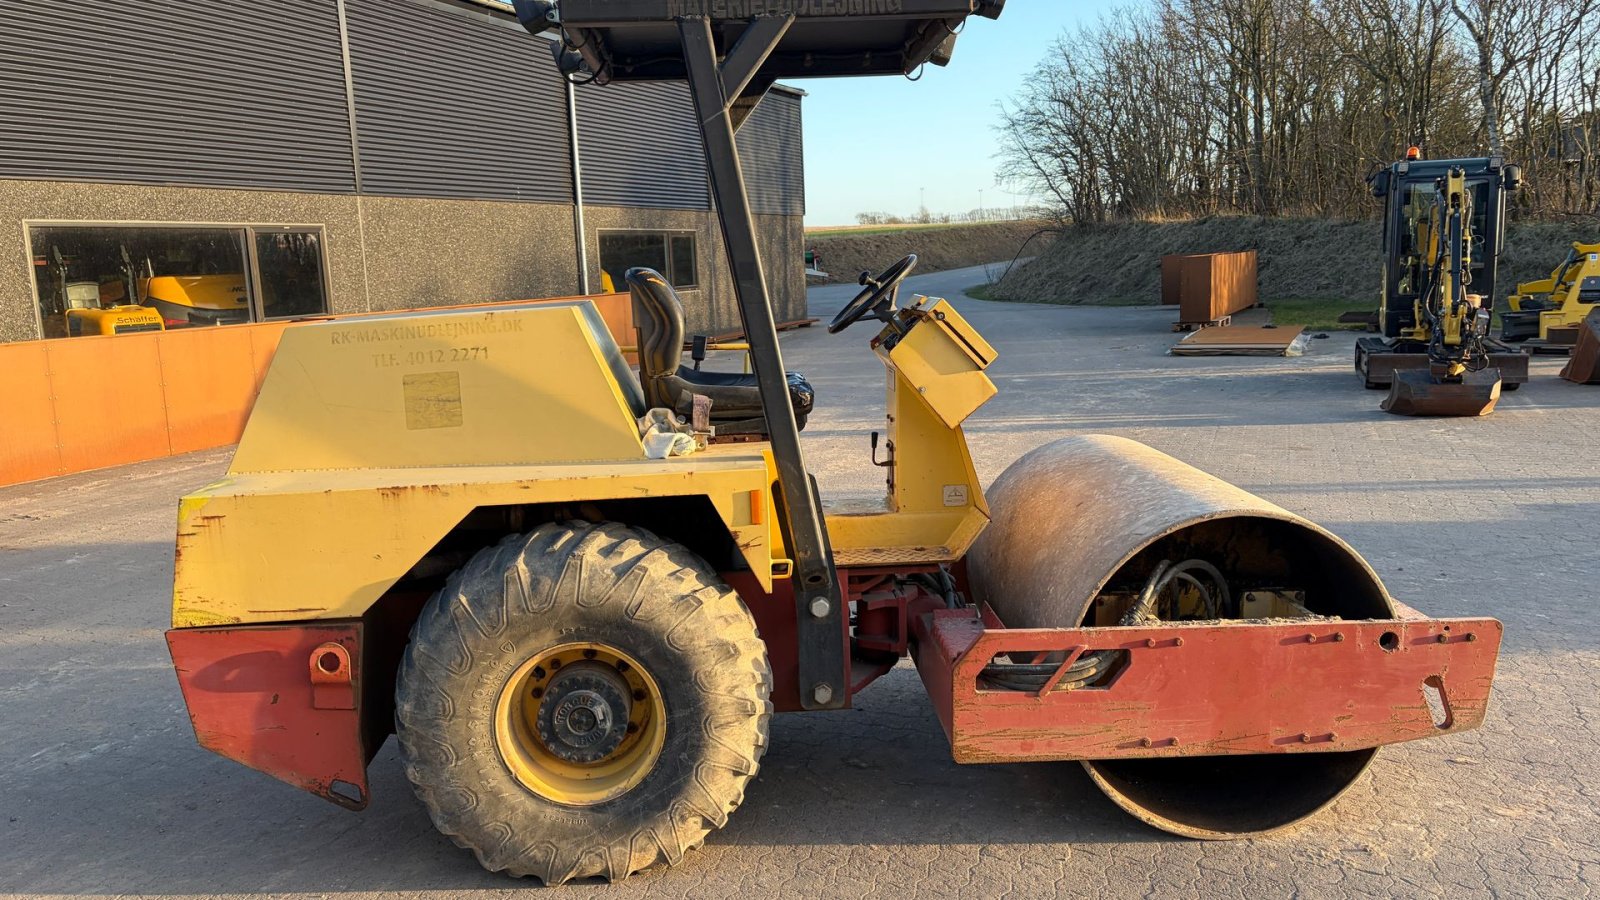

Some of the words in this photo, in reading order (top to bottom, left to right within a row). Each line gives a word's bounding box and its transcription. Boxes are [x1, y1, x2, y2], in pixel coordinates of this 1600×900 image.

[331, 319, 522, 344] RK-MASKINUDLEJNING.DK
[372, 352, 401, 368] TLF.
[406, 350, 445, 365] 4012
[451, 346, 488, 361] 2271
